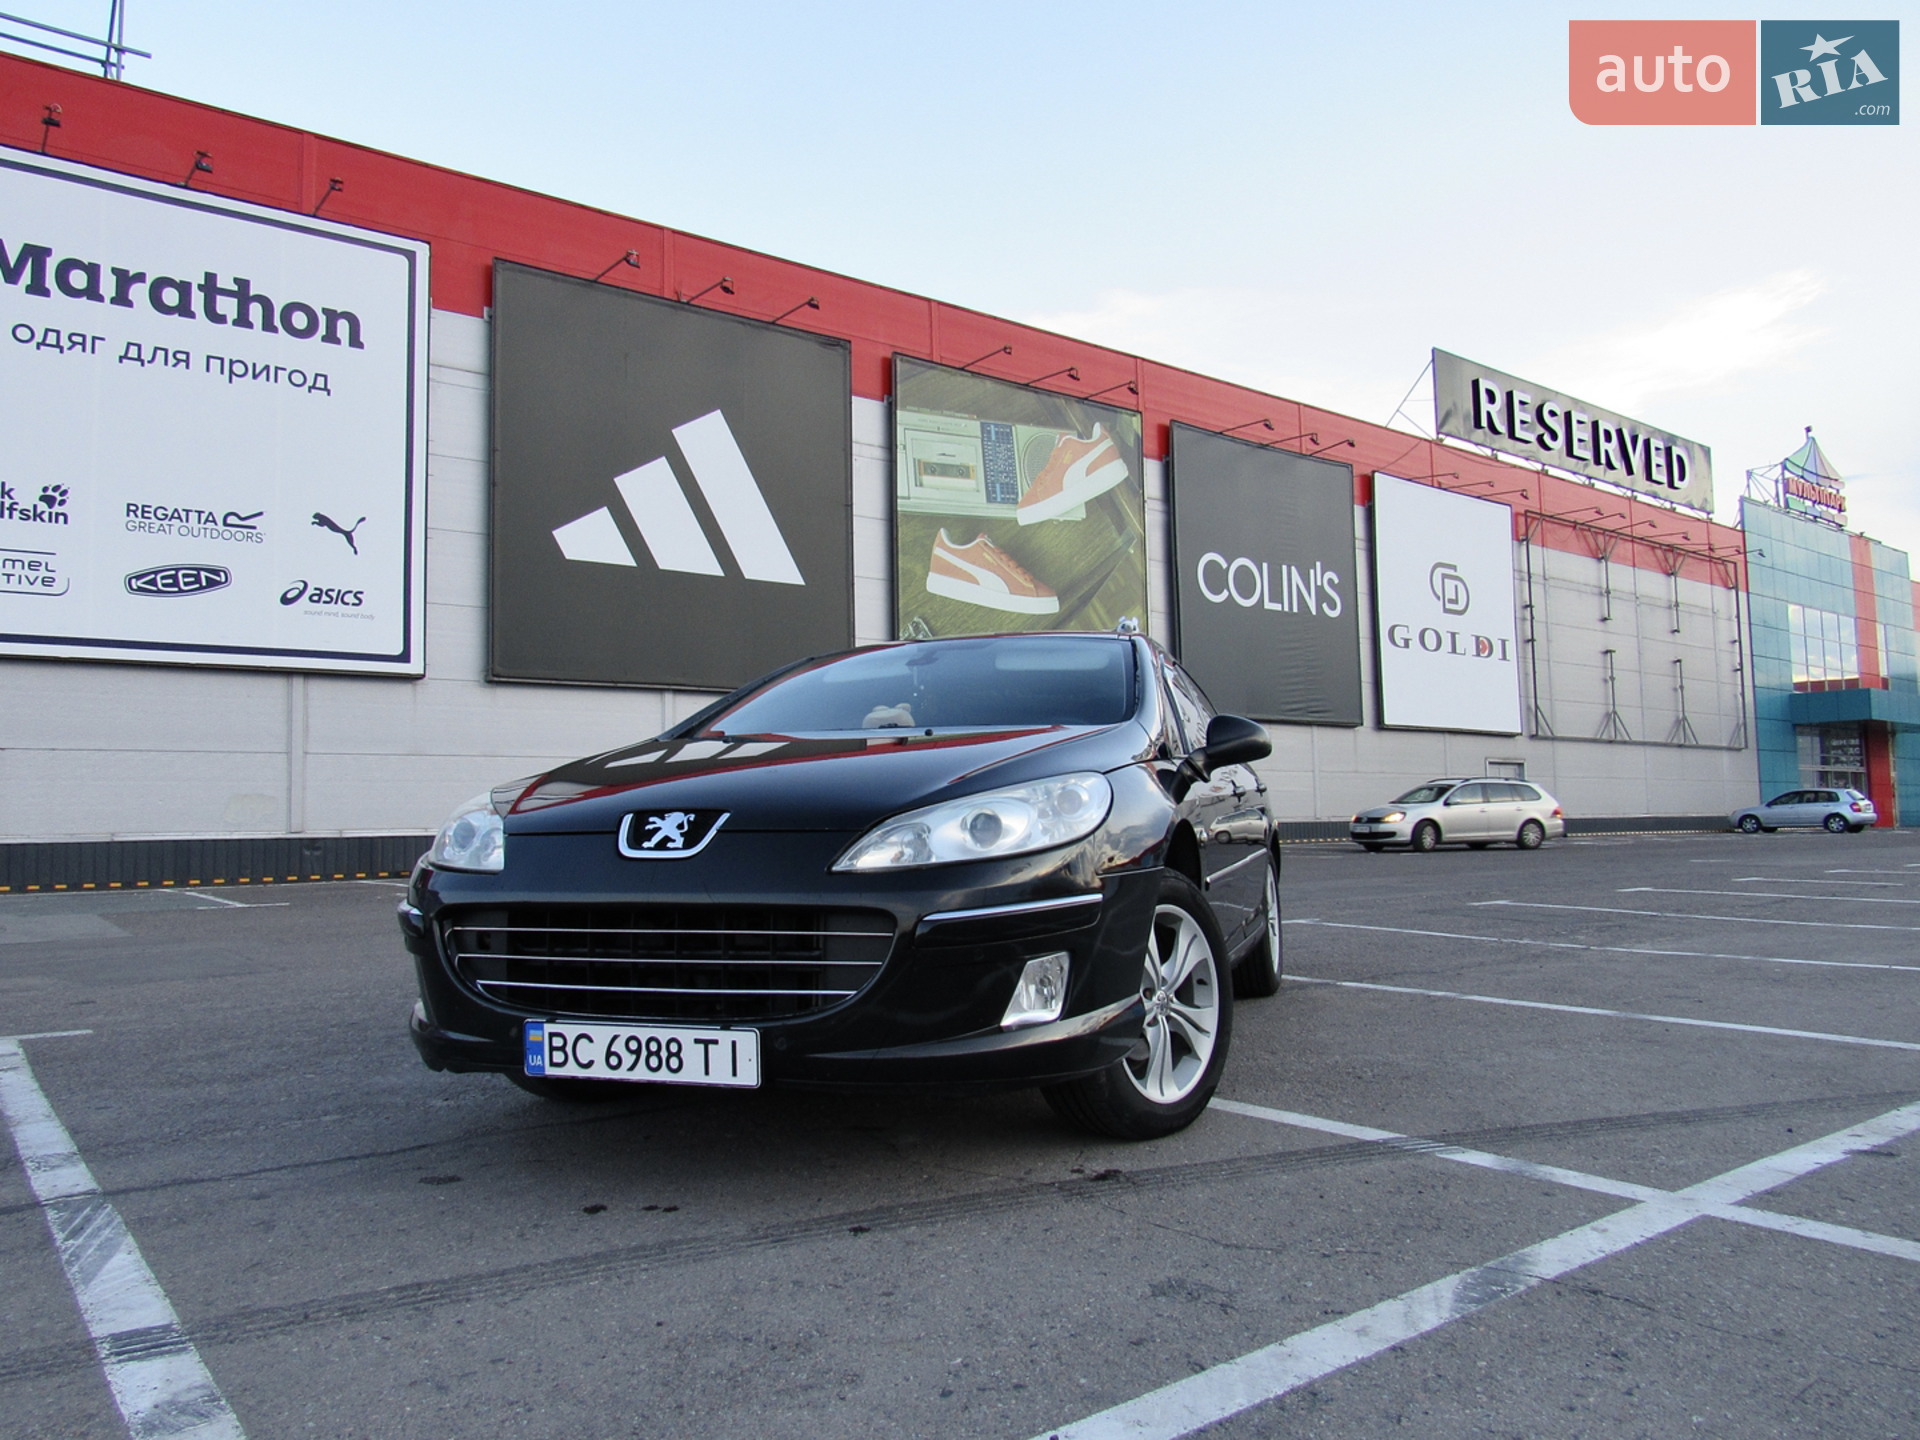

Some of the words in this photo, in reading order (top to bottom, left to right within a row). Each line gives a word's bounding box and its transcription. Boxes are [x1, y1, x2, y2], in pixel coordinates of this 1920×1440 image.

[0, 238, 365, 349] Marathon
[11, 322, 106, 355] одяг
[118, 340, 191, 370] для
[205, 353, 333, 396] пригод
[1471, 377, 1690, 490] RESERVED
[125, 502, 219, 527] REGATTA
[125, 519, 175, 535] GREAT
[177, 524, 264, 544] OUTDOORS
[130, 569, 226, 592] KEEN
[308, 586, 365, 607] asics
[1196, 551, 1343, 619] COLIN'S
[1387, 624, 1511, 662] GOLDI
[528, 1054, 543, 1067] UA
[548, 1031, 595, 1070] BC
[604, 1033, 684, 1074] 6988
